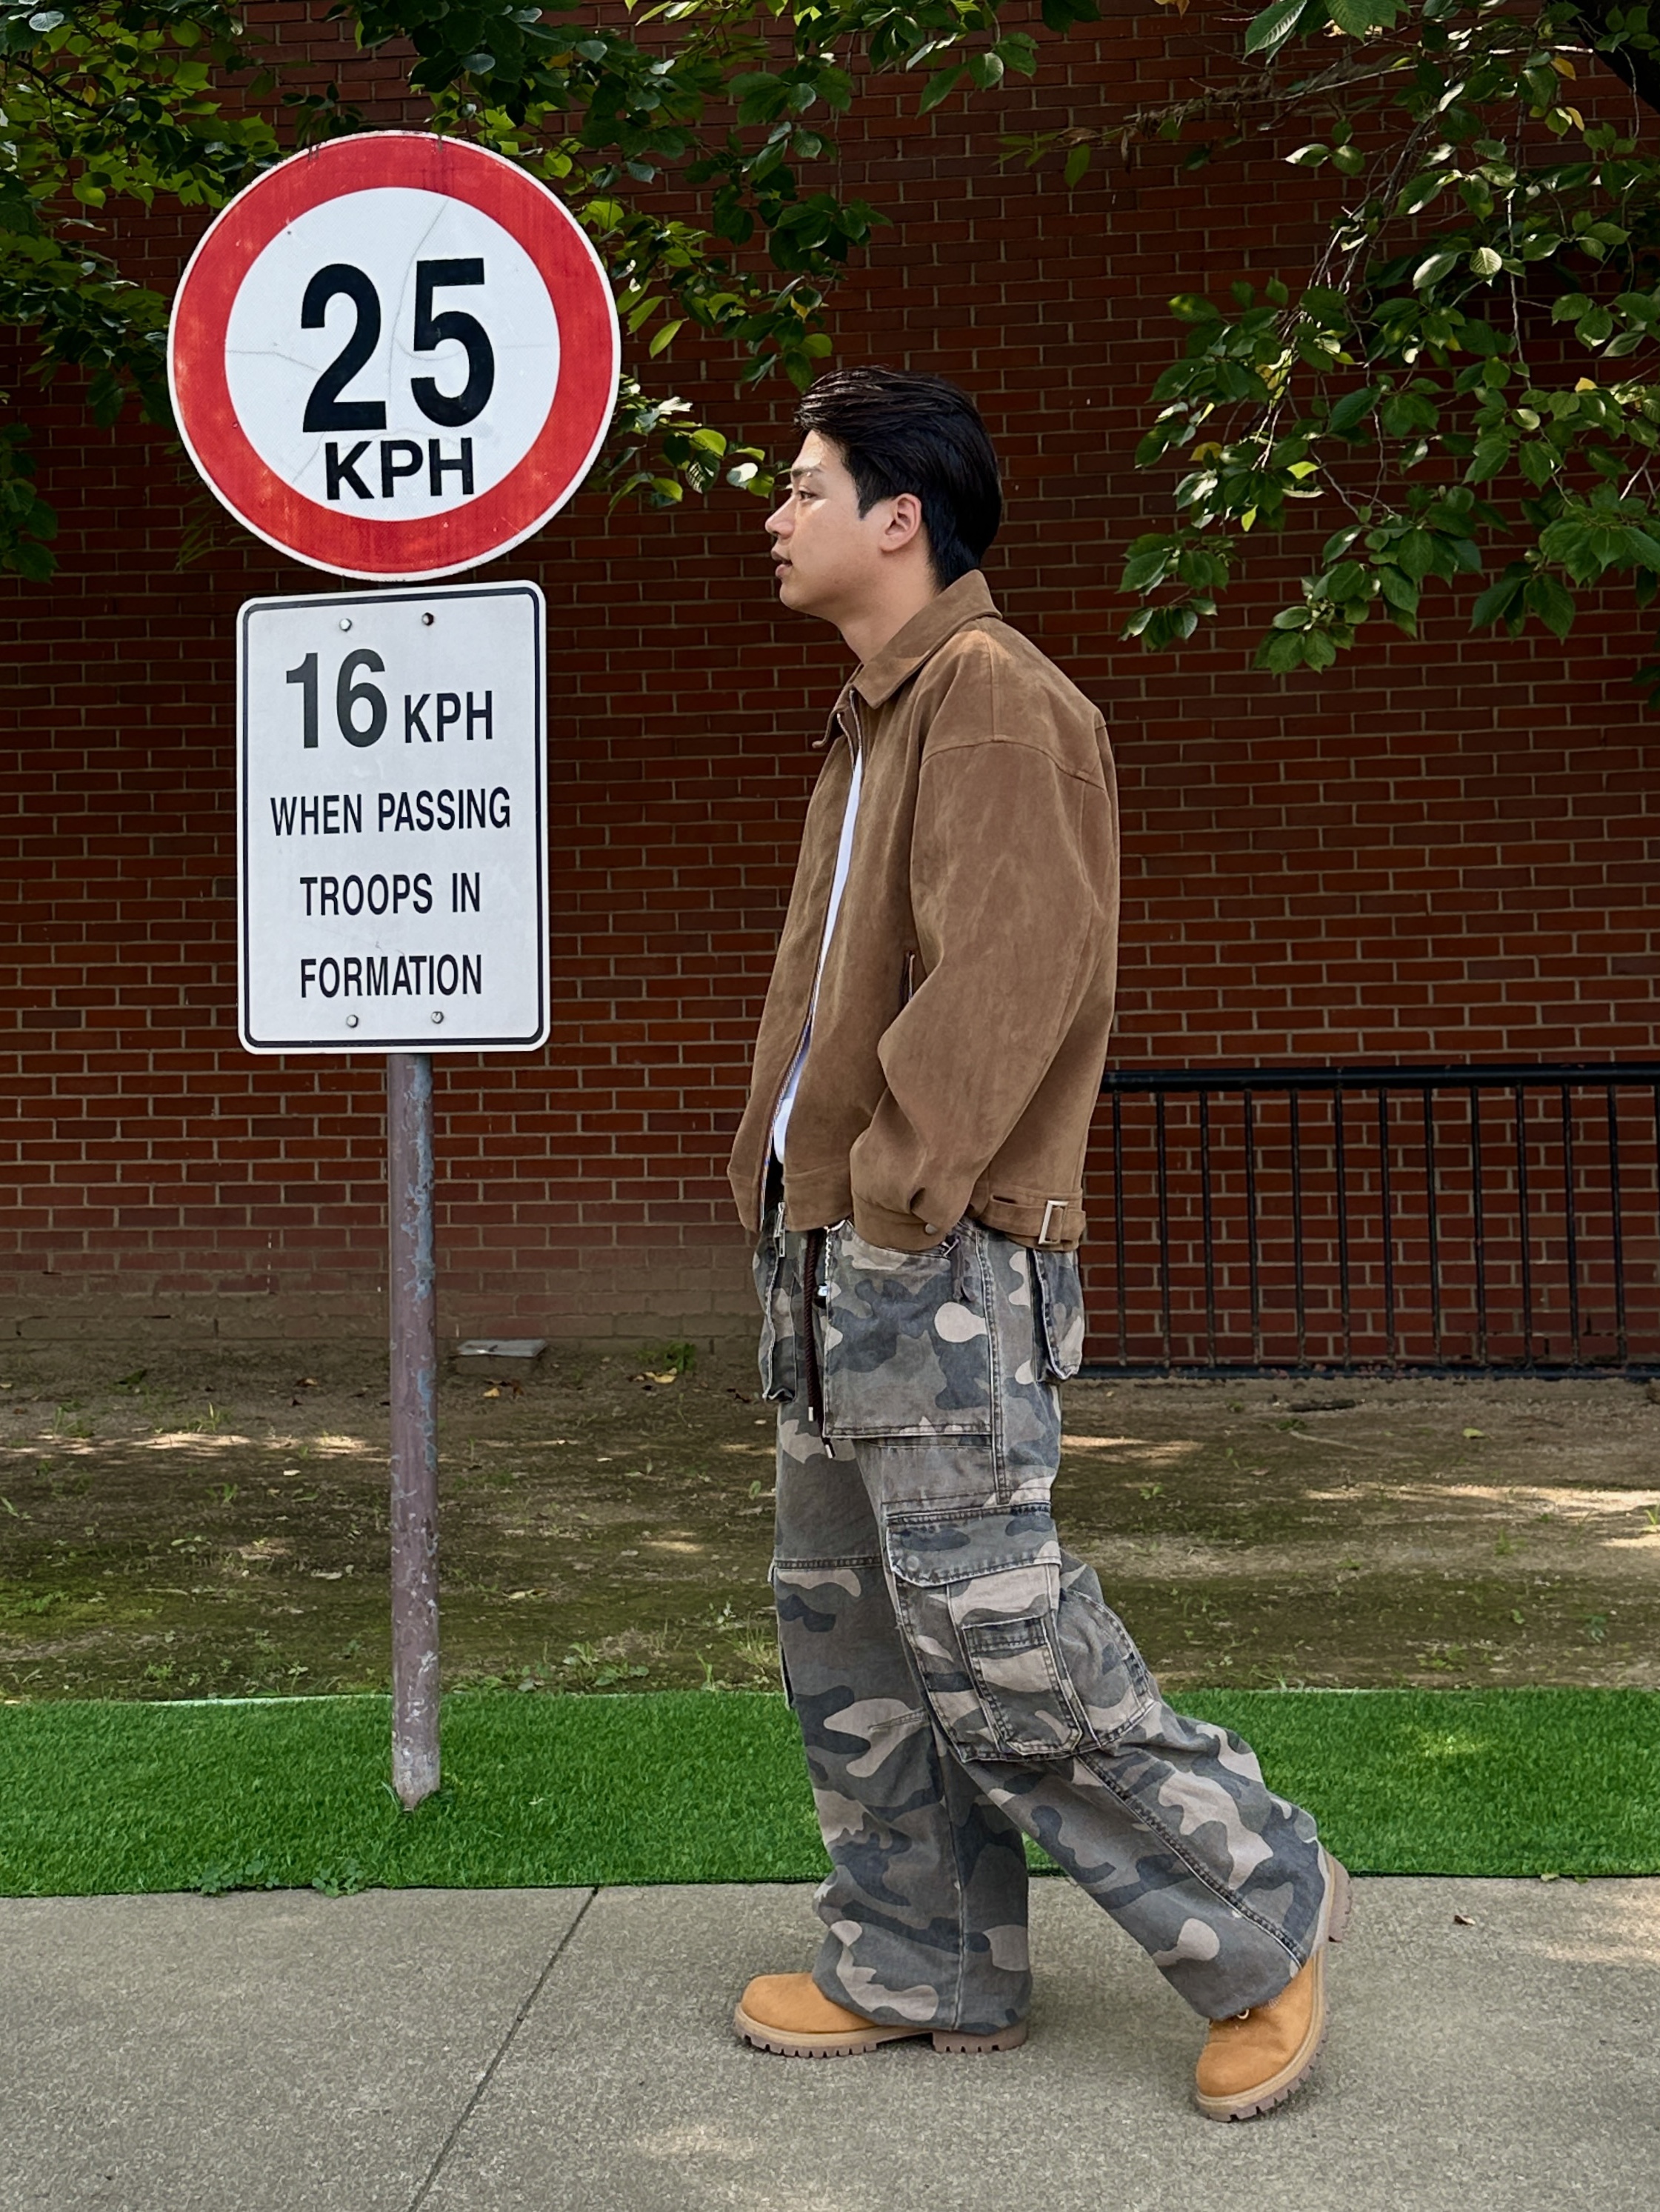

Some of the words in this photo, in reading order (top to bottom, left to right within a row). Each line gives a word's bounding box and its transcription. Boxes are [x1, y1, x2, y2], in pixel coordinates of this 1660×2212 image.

[301, 258, 495, 433] 25
[324, 437, 475, 501] KPH
[286, 648, 387, 749] 16
[404, 690, 493, 744] KPH
[270, 793, 362, 836] WHEN
[378, 786, 511, 833] PASSING
[299, 873, 433, 916] TROOPS
[452, 872, 481, 913] IN
[300, 953, 482, 999] FORMATION
